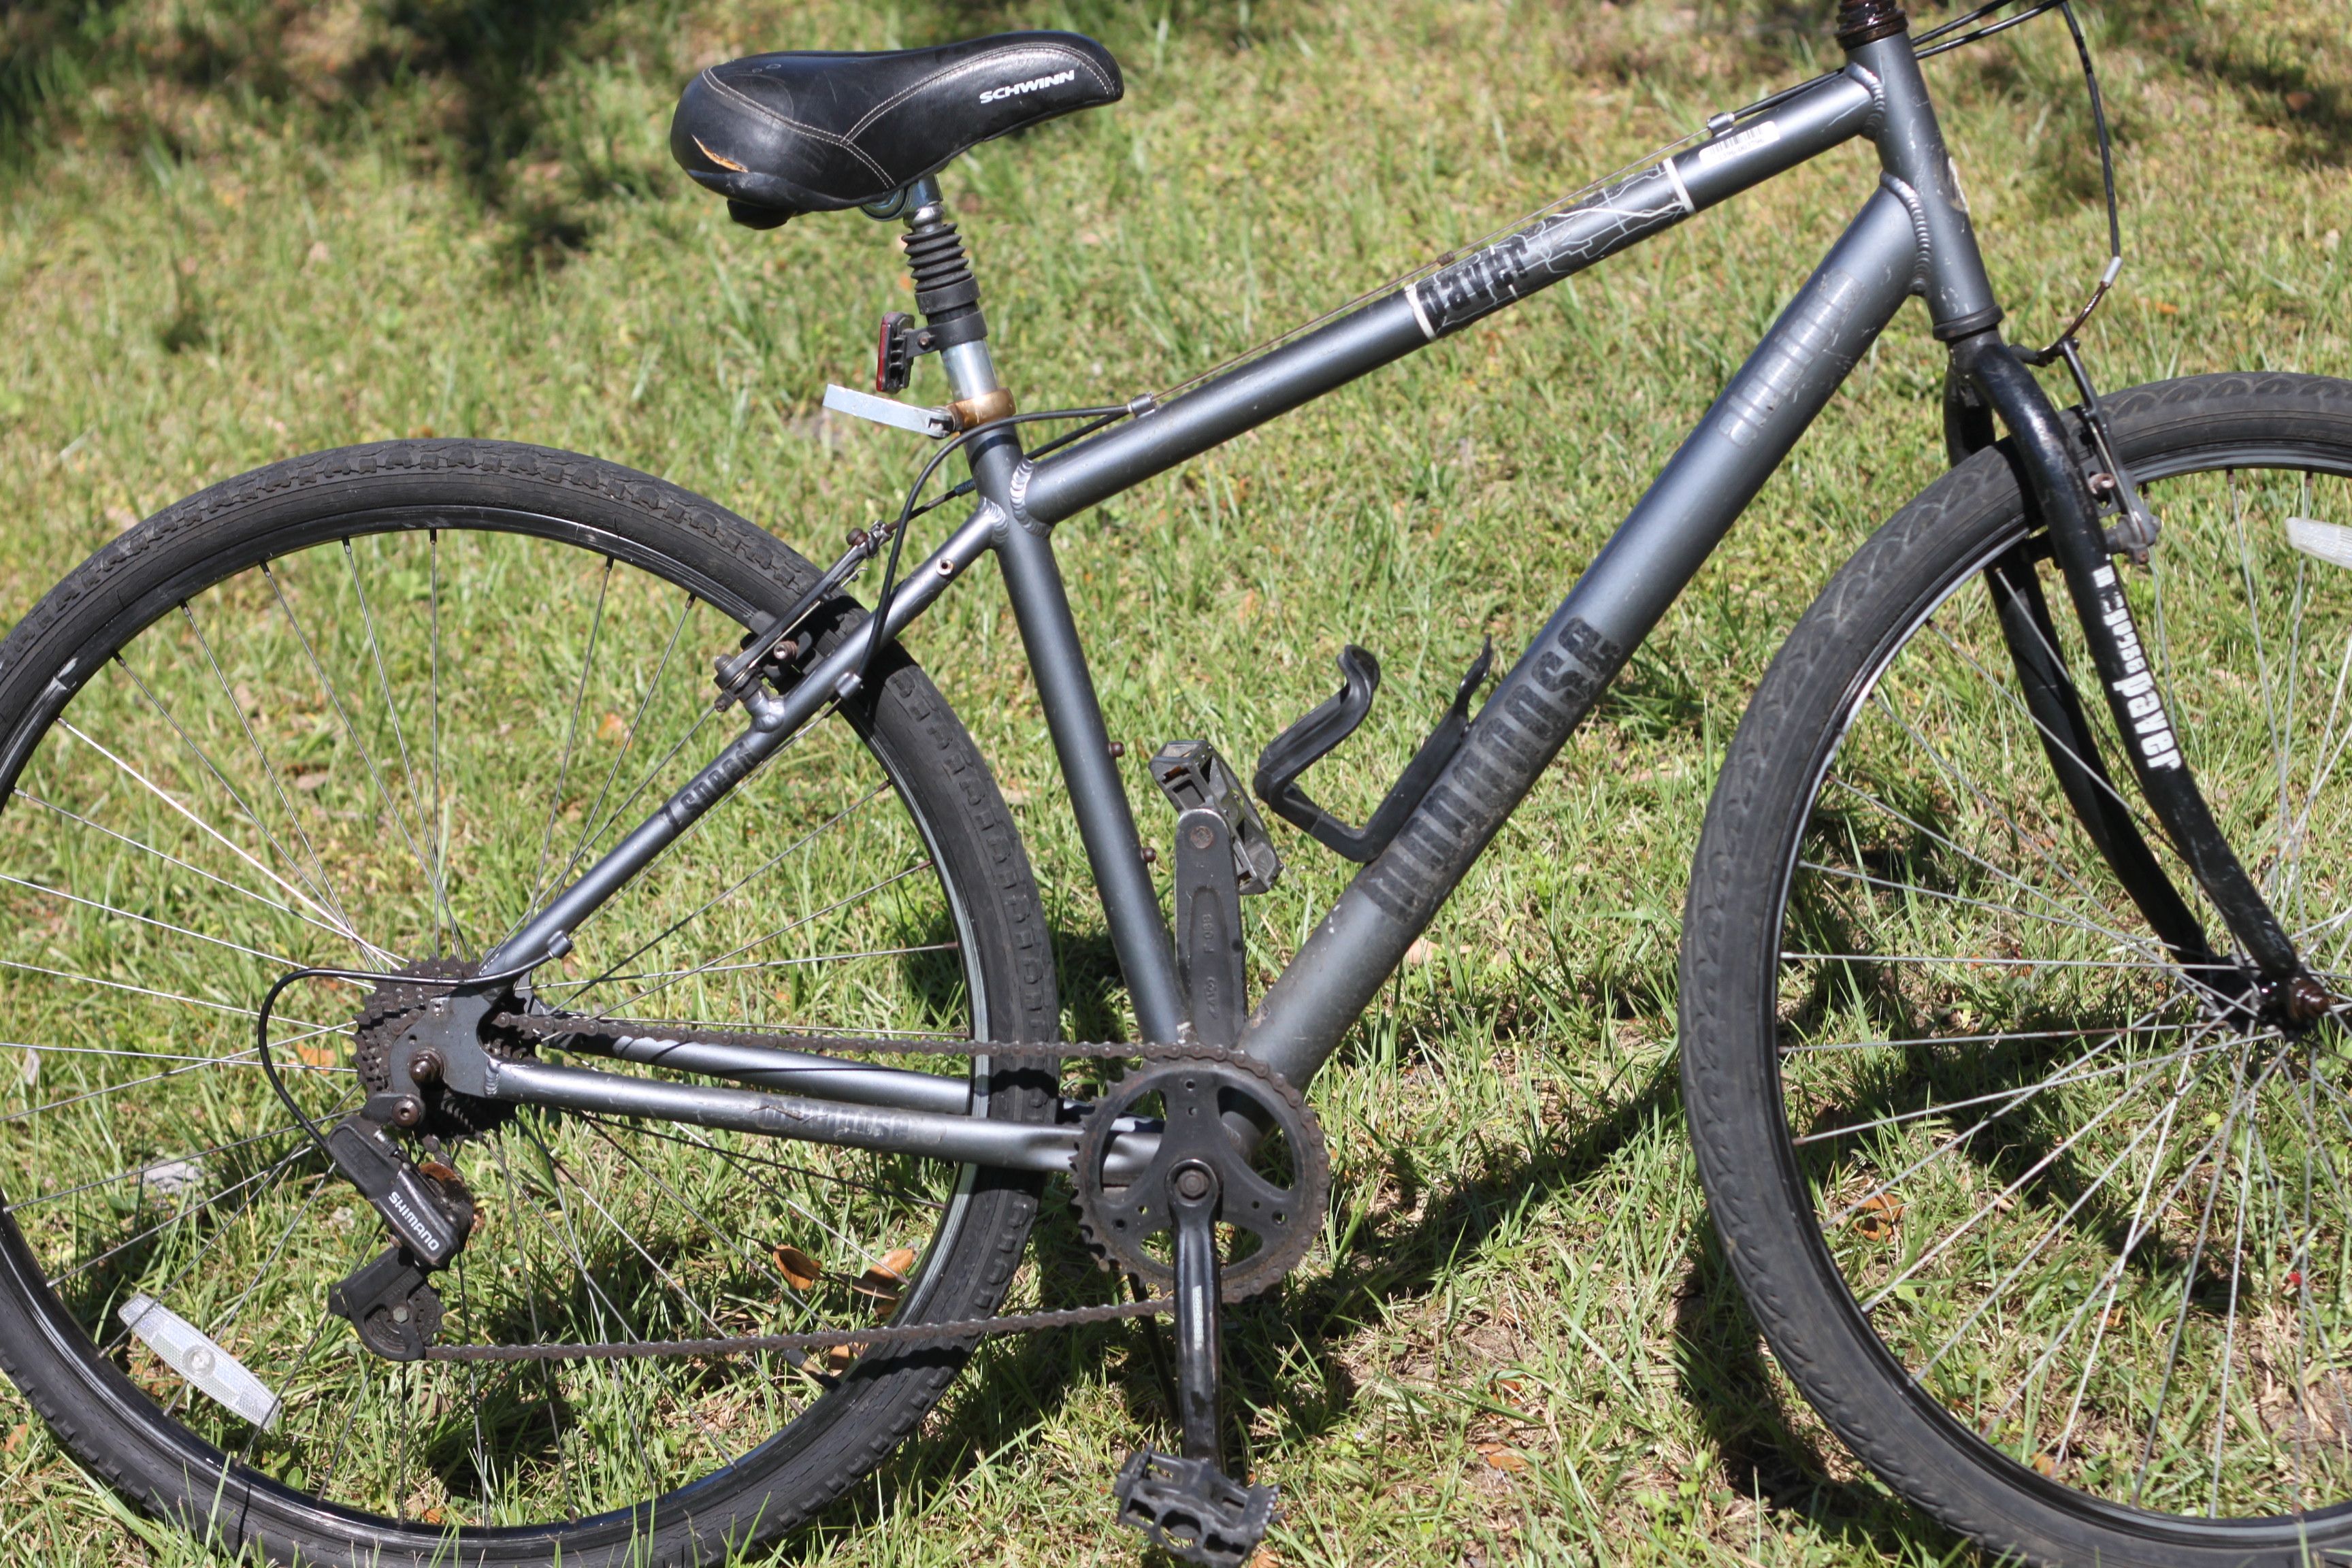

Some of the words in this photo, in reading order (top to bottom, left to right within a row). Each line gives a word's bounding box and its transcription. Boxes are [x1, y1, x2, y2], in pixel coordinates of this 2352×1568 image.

[979, 69, 1075, 103] SCHWINN
[2112, 670, 2182, 770] paver
[389, 1191, 440, 1251] SHIMANO
